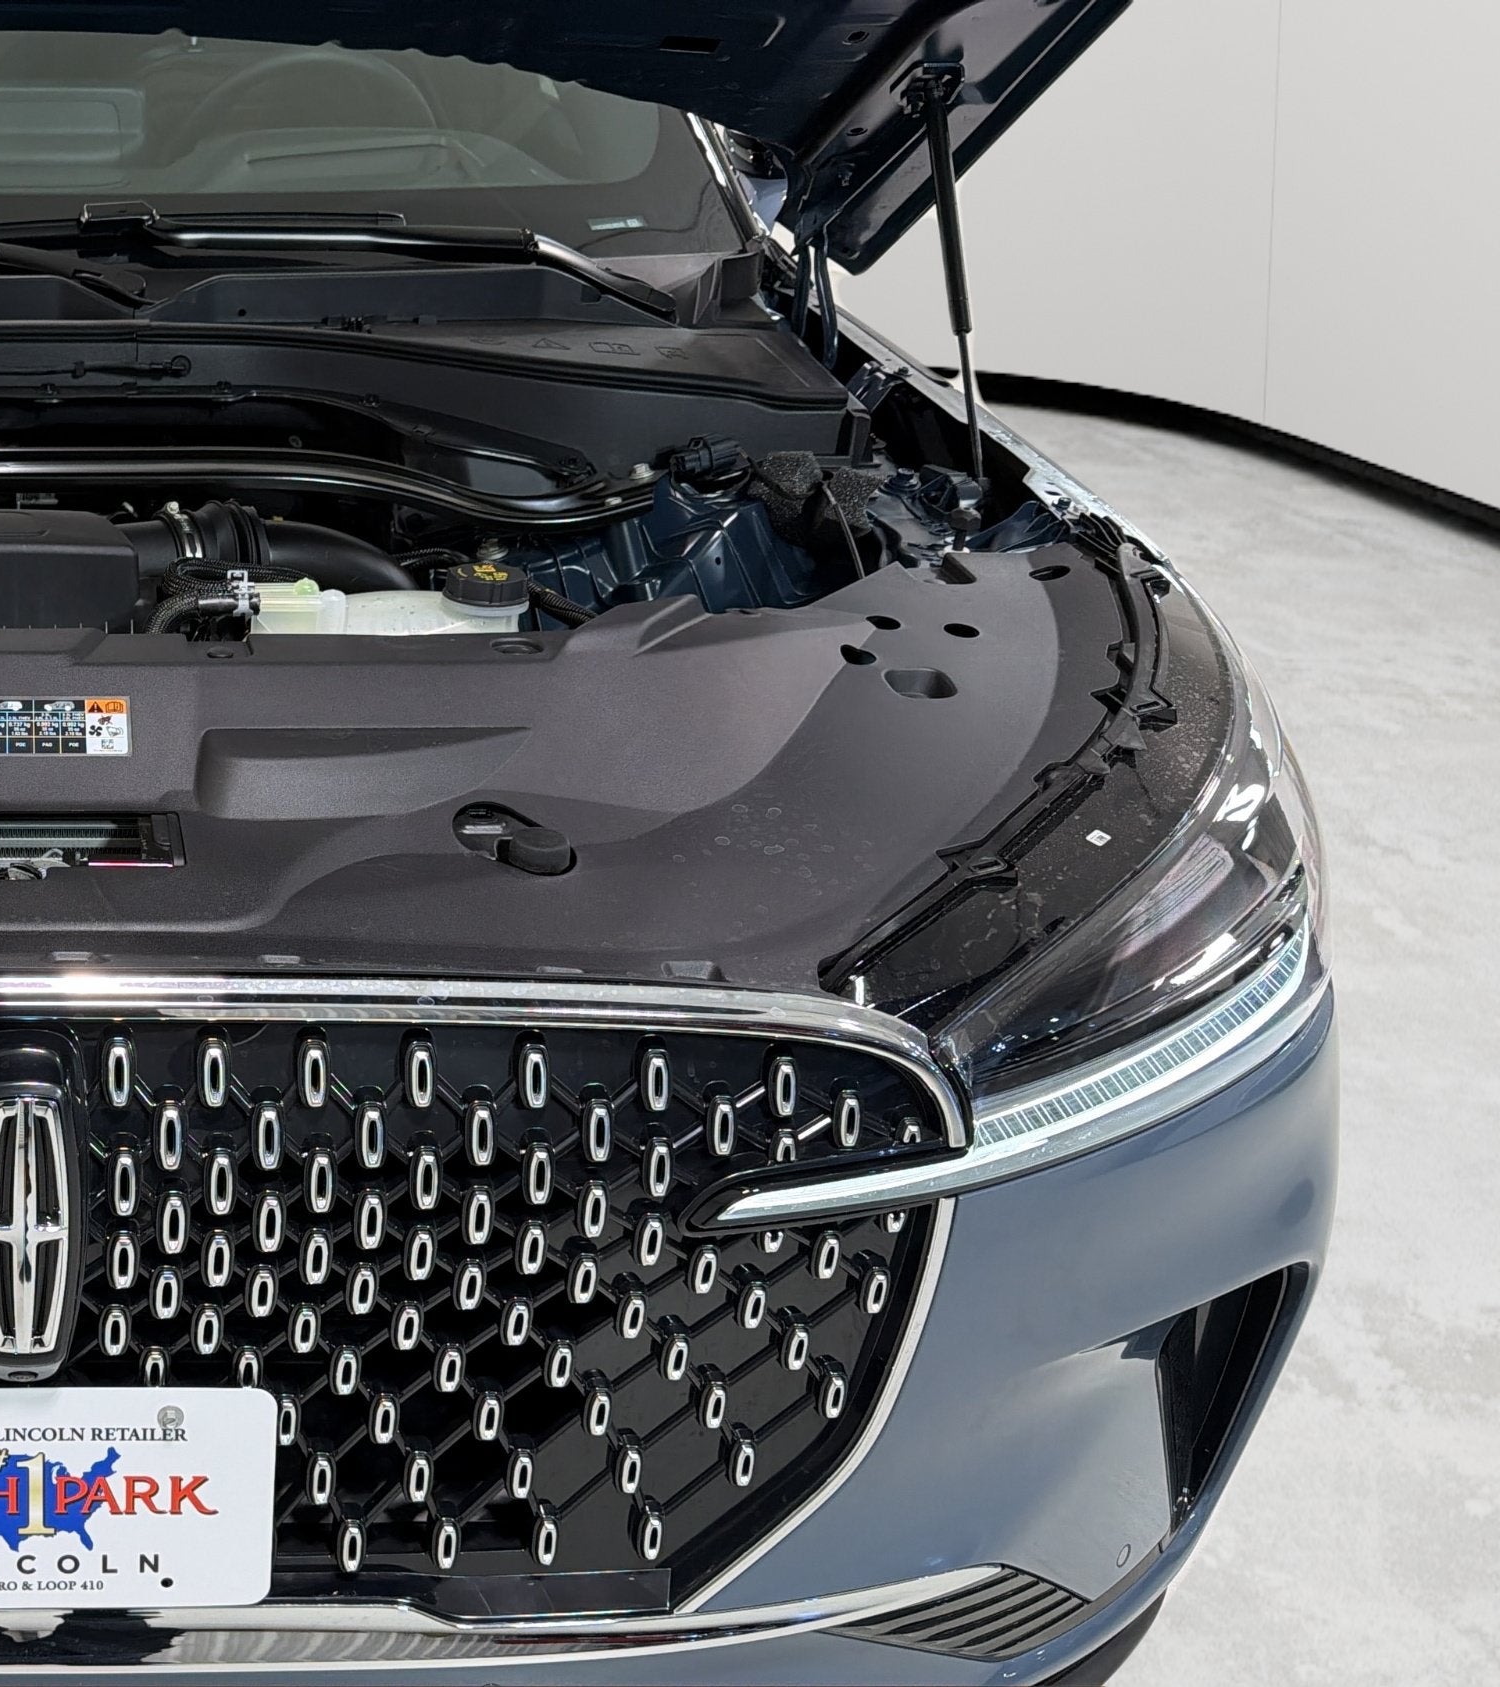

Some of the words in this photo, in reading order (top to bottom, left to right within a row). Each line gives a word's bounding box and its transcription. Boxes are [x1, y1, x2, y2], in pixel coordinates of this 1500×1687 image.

[90, 1427, 188, 1442] RETAILER
[54, 1475, 219, 1516] PARK
[21, 1580, 33, 1591] &
[37, 1580, 77, 1591] LOOP
[80, 1580, 104, 1591] 410
